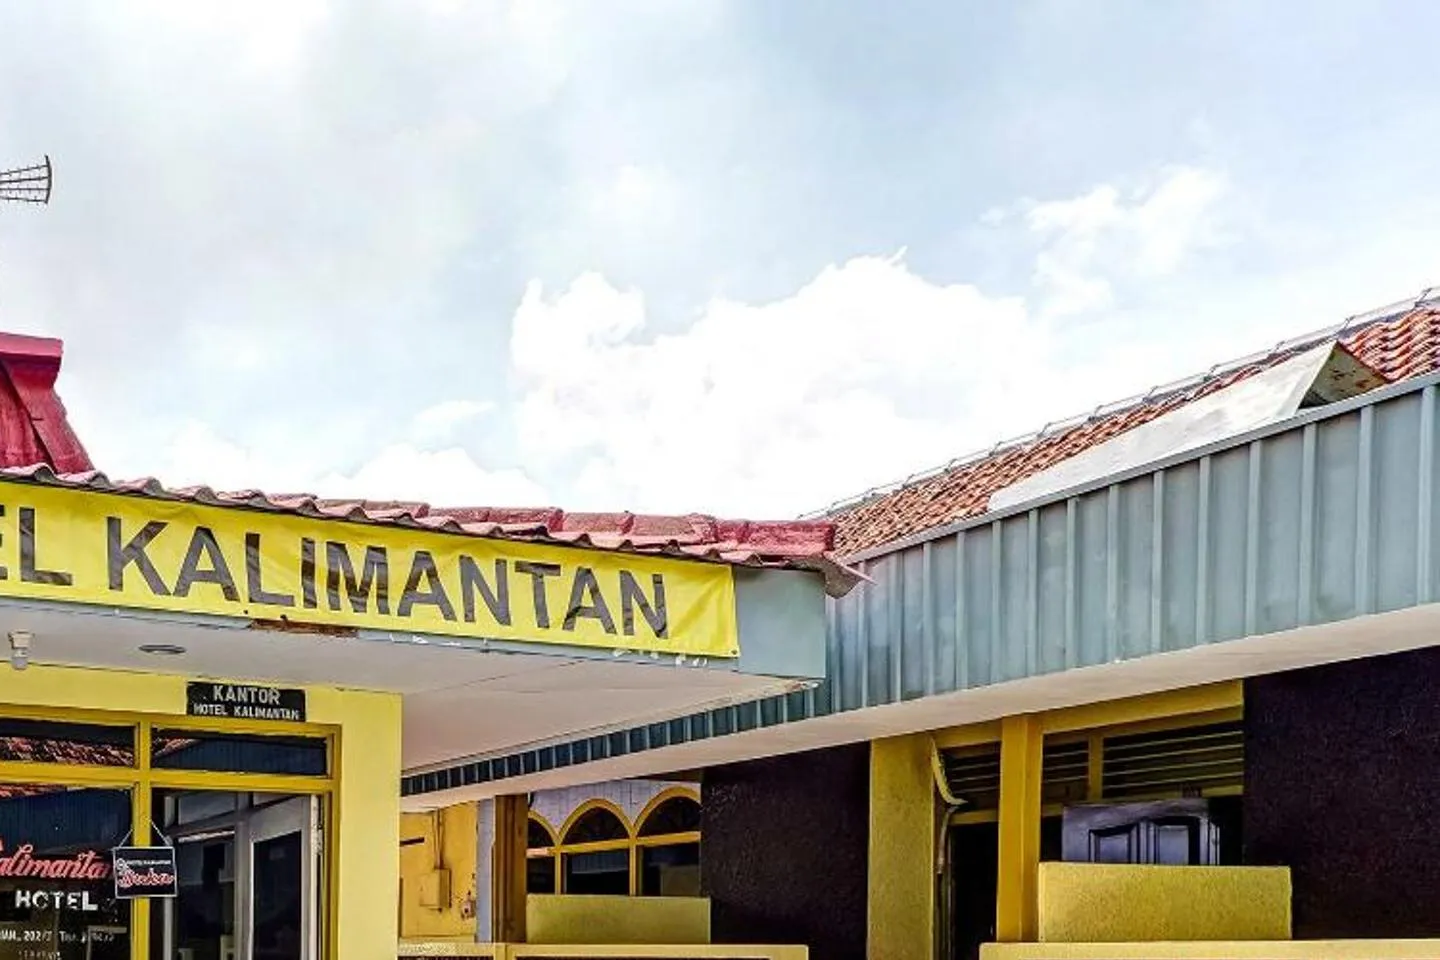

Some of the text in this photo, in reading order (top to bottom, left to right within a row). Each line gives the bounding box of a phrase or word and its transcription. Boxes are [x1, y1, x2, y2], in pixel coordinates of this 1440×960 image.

[104, 515, 670, 640] KALIMANTAN
[212, 684, 281, 706] KANTOR
[192, 702, 301, 721] HOTEL KALIMANTAN
[14, 889, 99, 911] HOTEL
